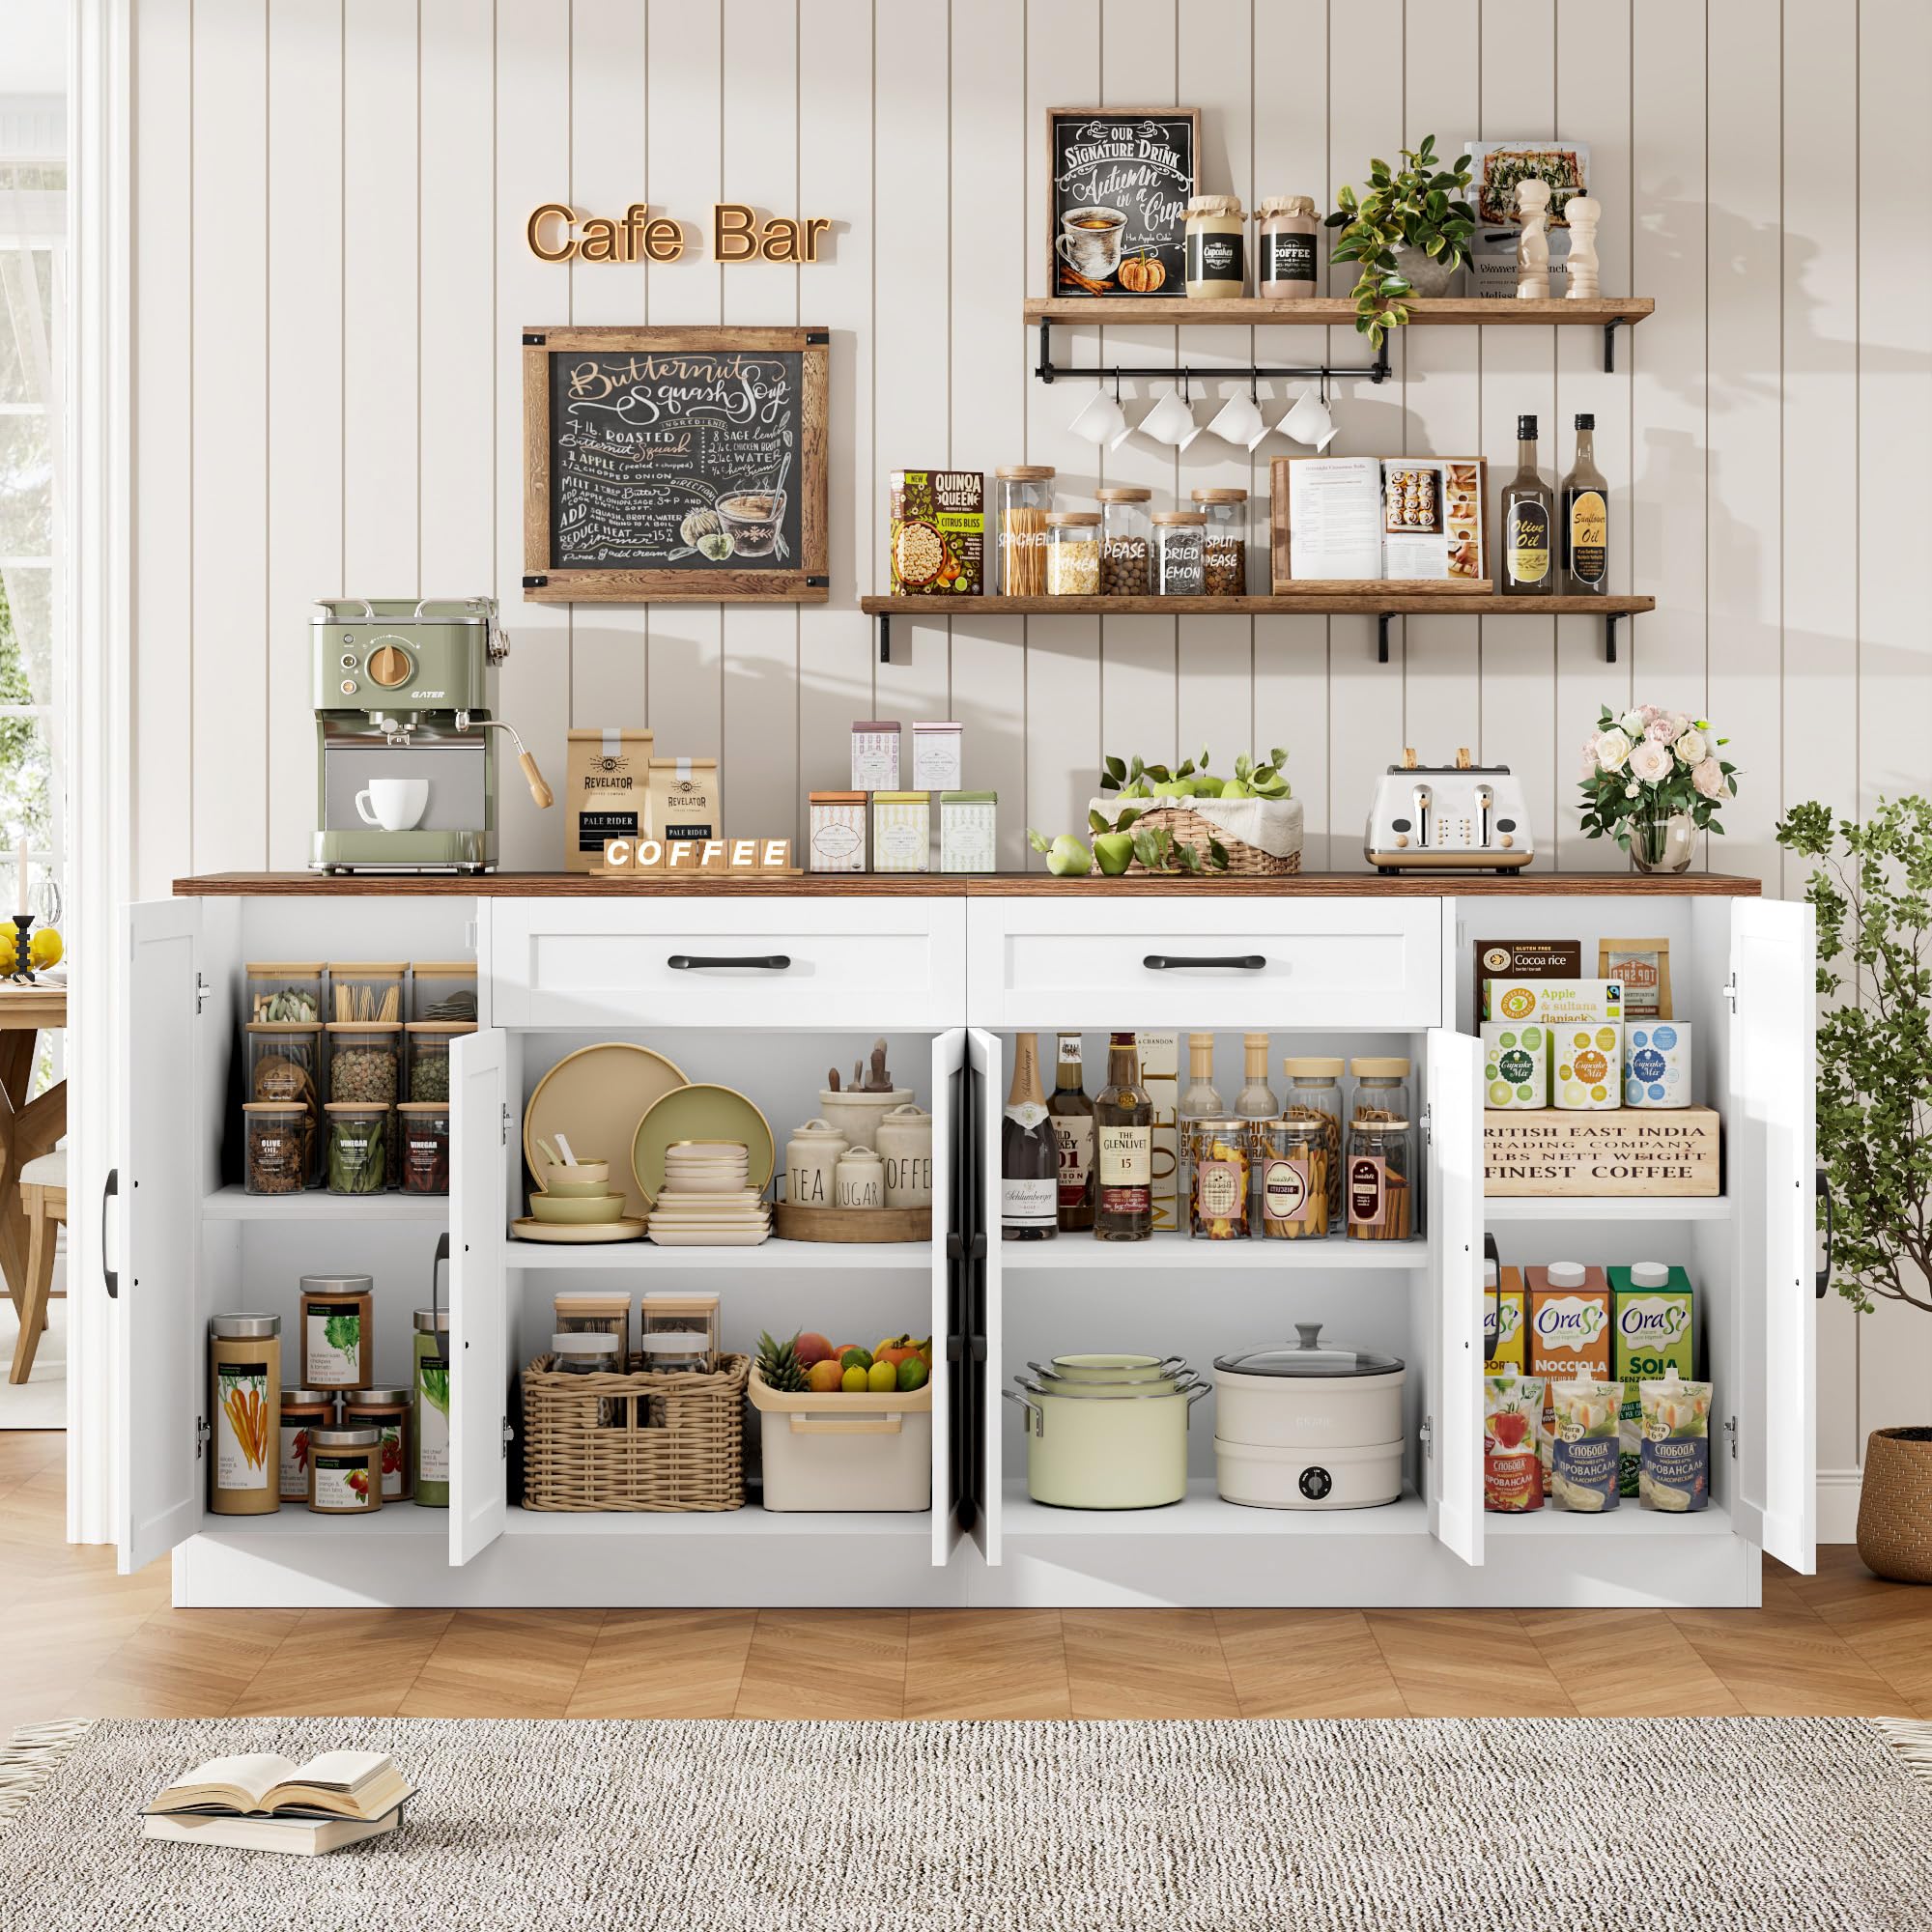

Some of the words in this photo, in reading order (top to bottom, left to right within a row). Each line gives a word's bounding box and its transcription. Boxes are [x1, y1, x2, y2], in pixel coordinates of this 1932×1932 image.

[1111, 127, 1133, 141] OUR
[1072, 164, 1162, 205] Autumn
[526, 203, 684, 264] Cafe
[713, 203, 833, 264] Bar
[1138, 234, 1155, 242] Apple
[1204, 246, 1234, 260] Cupcakes
[1274, 249, 1311, 259] COFFEE
[568, 355, 785, 400] Butternut
[568, 380, 737, 425] Squash
[686, 365, 791, 423] Soup
[606, 430, 675, 443] ROASTED
[724, 430, 750, 440] SAGE
[559, 434, 636, 455] Butternut
[633, 432, 694, 463] Squash
[734, 442, 759, 452] CHICKEN
[580, 453, 616, 470] APPLE
[734, 448, 781, 463] WATER
[582, 466, 630, 481] CHOPPED
[911, 474, 924, 483] NEW
[562, 476, 590, 492] MELT
[621, 486, 671, 499] Butter
[670, 478, 716, 502] DIRECTIONS
[935, 473, 981, 494] QUINOA
[561, 489, 577, 503] ADD
[568, 496, 590, 506] COOK
[941, 491, 975, 506] QUEEN
[560, 503, 587, 528] ADD
[941, 518, 963, 527] CITRUS
[963, 518, 980, 527] BLISS
[1574, 513, 1605, 526] Sunflower
[559, 523, 600, 543] REDUCE
[603, 526, 632, 537] HEAT
[1511, 520, 1545, 533] Olive
[1207, 534, 1235, 549] SPLIT
[1516, 533, 1540, 547] Oil
[1581, 528, 1600, 543] Oil
[1103, 542, 1147, 559] PEASE
[1164, 547, 1200, 561] DRIED
[584, 776, 633, 790] REVELATOR
[668, 796, 706, 808] REVELATOR
[607, 816, 633, 825] RIDER
[607, 840, 789, 867] COFFEE
[1515, 954, 1547, 965] Cocoa
[1548, 954, 1567, 965] rice
[1541, 988, 1576, 1001] Apple
[1553, 1001, 1597, 1010] sultana
[1500, 1061, 1532, 1071] Cupcake
[1575, 1061, 1605, 1071] Cupcake
[1634, 1059, 1664, 1070] Cupcake
[1643, 1066, 1661, 1076] Mix
[1513, 1067, 1529, 1077] Mix
[1586, 1068, 1602, 1078] Mix
[1570, 1127, 1627, 1137] EAST
[1638, 1127, 1707, 1137] INDIA
[1103, 1139, 1148, 1151] GLENLIVET
[1589, 1141, 1697, 1150] COMPANY
[1121, 1158, 1132, 1169] 15
[1492, 1152, 1531, 1161] LBS
[1543, 1152, 1603, 1161] NETT
[1613, 1152, 1707, 1161] WEIGHT
[1484, 1166, 1577, 1179] FINEST
[1591, 1166, 1692, 1179] COFFEE
[791, 1168, 824, 1201] TEA
[837, 1181, 879, 1207] SUGAR
[1005, 1189, 1053, 1204] Schlumberger
[1535, 1359, 1607, 1373] NOCCIOLA
[1629, 1356, 1680, 1375] SOIA
[1560, 1460, 1616, 1476] ПРОВАНСАЛЬ
[1647, 1460, 1703, 1476] ПРОВАНСАЛЬ
[1485, 1473, 1533, 1487] ПРОВАНСАЛЬ
